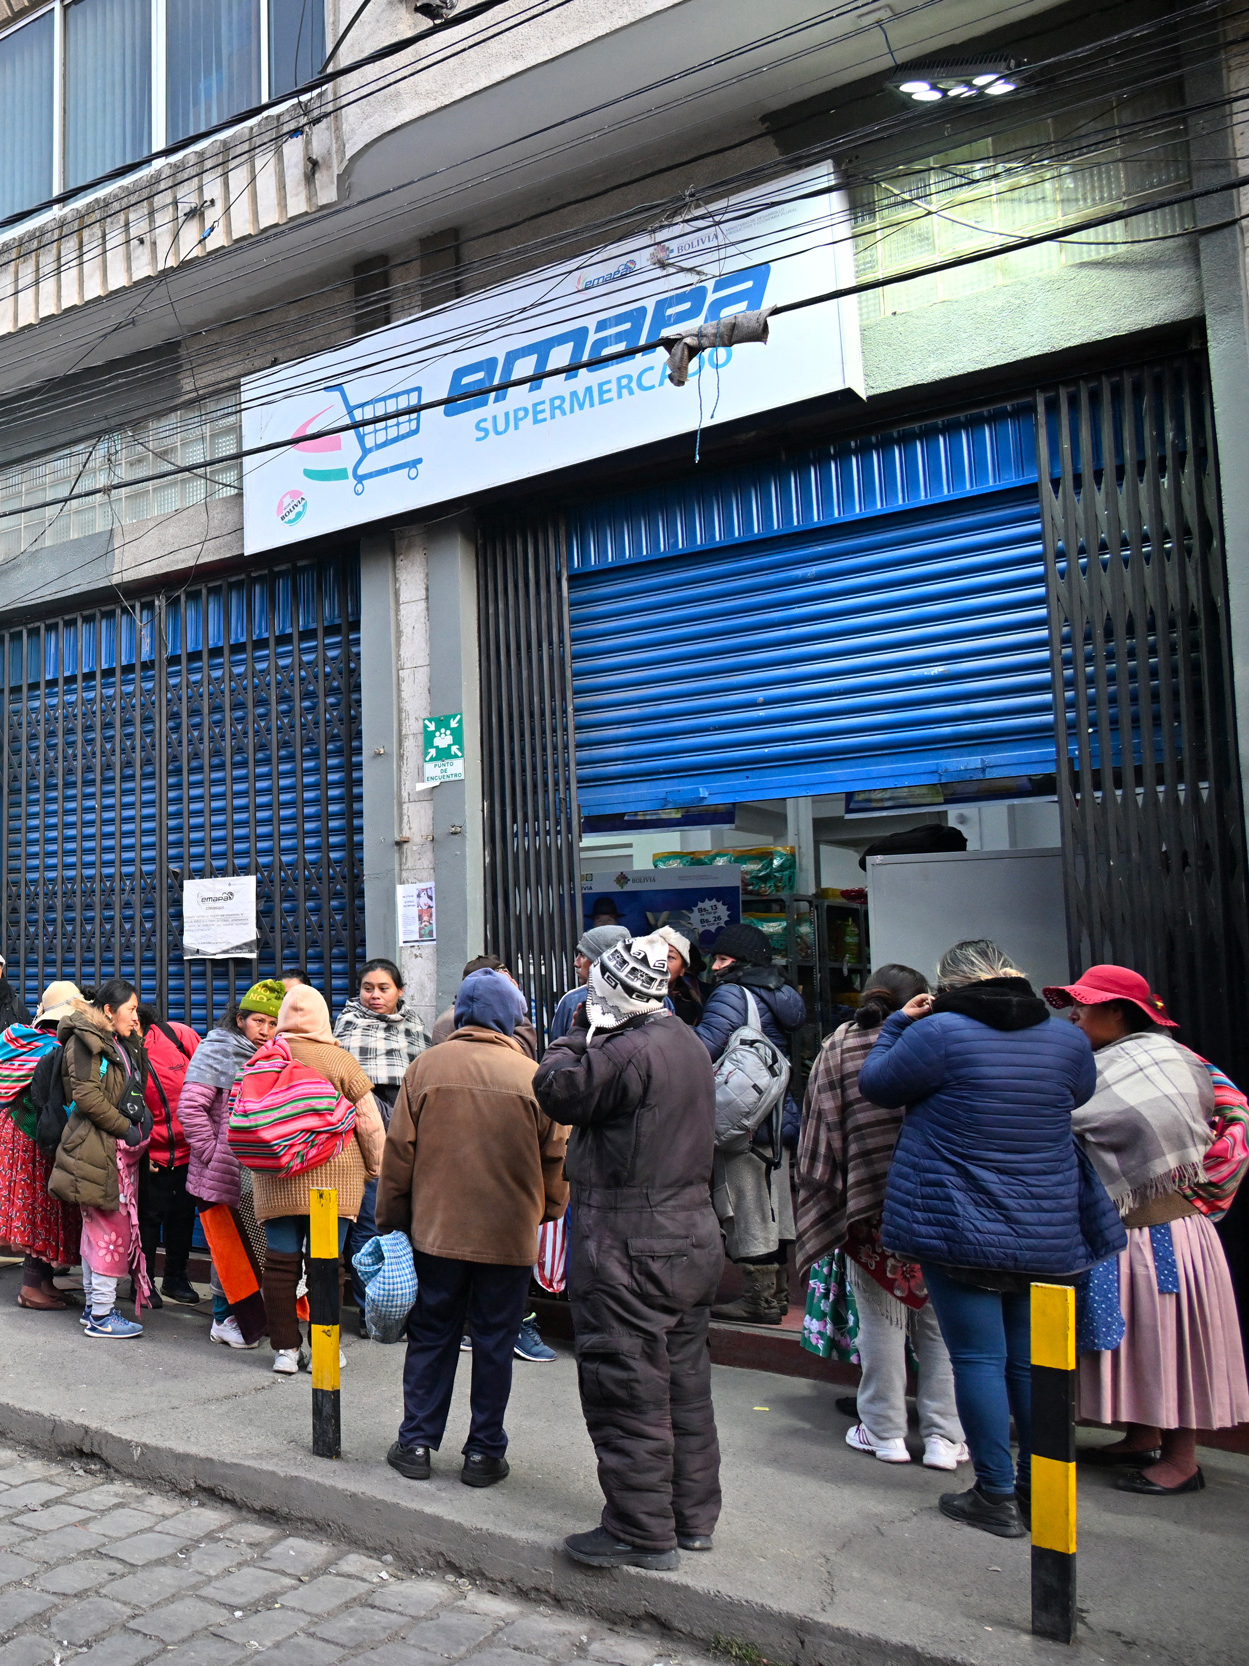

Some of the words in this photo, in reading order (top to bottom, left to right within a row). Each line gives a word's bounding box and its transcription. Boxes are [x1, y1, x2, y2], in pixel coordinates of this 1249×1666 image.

[676, 232, 719, 254] BOLIVIA
[443, 263, 771, 418] emapa
[280, 497, 305, 521] BOLIVIA
[433, 761, 454, 769] PUNTO
[426, 772, 462, 782] ENCUENTRO
[201, 895, 229, 903] emapa
[710, 904, 718, 912] 13
